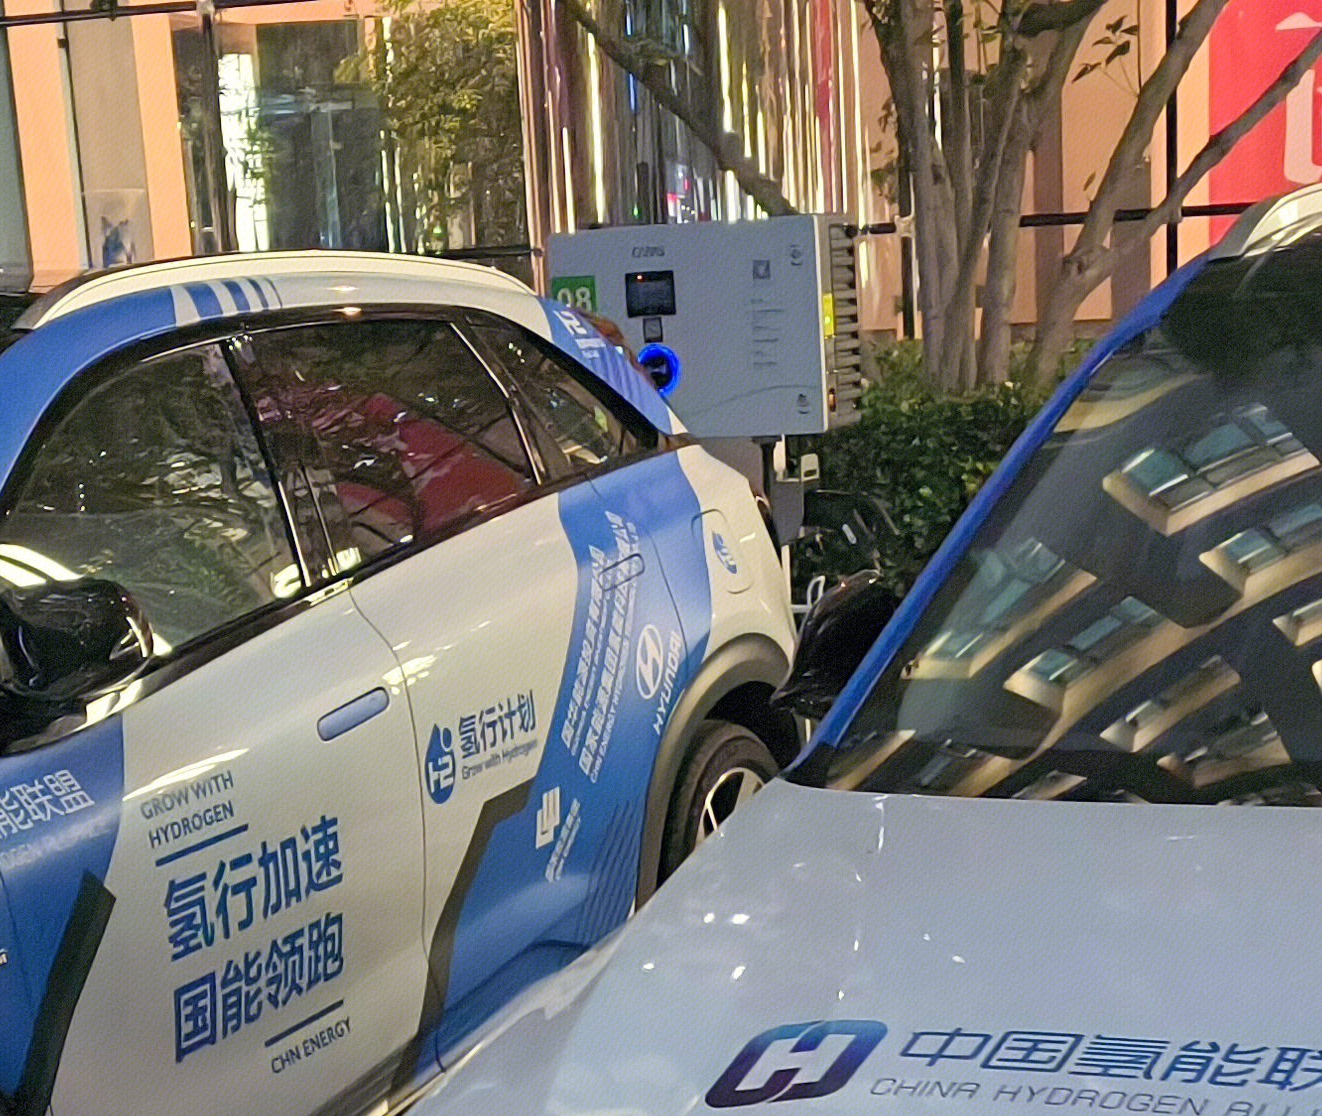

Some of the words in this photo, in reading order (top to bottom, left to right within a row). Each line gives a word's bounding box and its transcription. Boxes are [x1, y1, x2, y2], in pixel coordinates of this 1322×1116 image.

[653, 629, 682, 736] HYUNDAI
[458, 689, 536, 759] 氢行计划
[140, 789, 189, 820] GROW
[191, 770, 234, 801] WITH
[148, 800, 235, 849] HYDROGEN
[164, 815, 344, 962] 氢行加速
[174, 911, 344, 1064] 国能领跑
[271, 1044, 303, 1074] CHN
[303, 1016, 351, 1059] ENERGY
[870, 1078, 981, 1100] CHINA
[992, 1084, 1210, 1116] HYDROGEN
